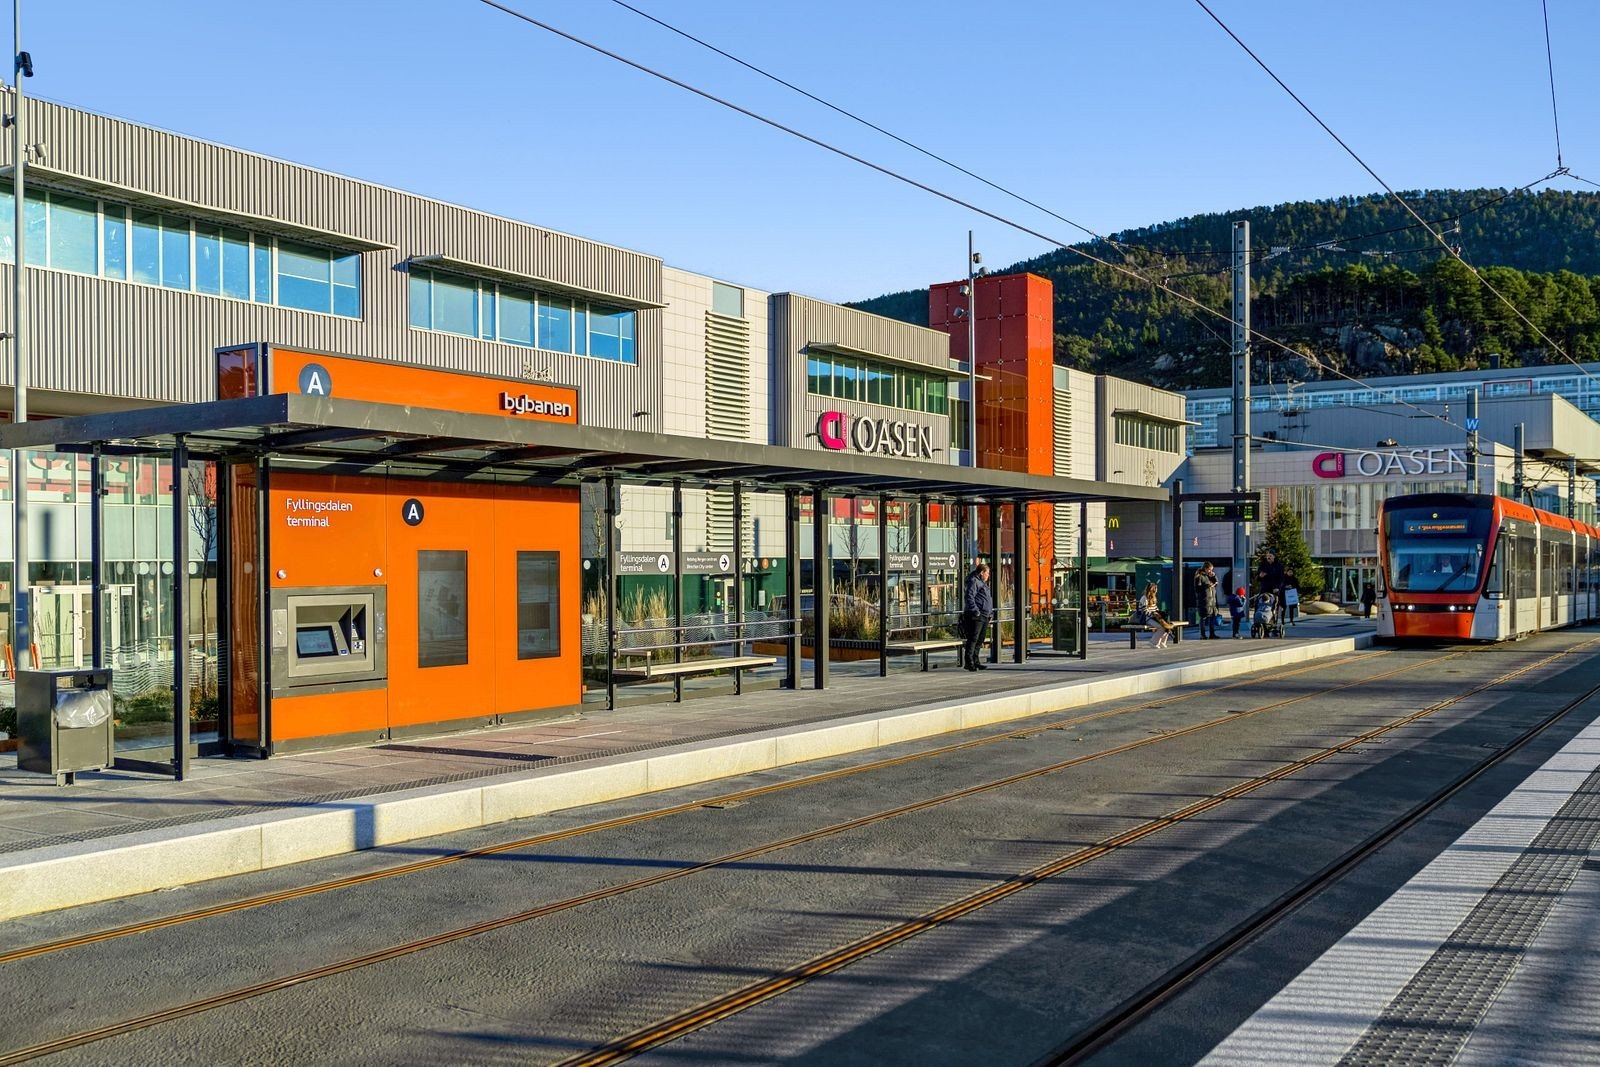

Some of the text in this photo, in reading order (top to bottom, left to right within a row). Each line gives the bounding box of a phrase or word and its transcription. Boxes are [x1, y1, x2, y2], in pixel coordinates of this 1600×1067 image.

[307, 371, 325, 395] A
[504, 391, 572, 416] bybanen
[1467, 420, 1479, 431] W
[856, 416, 933, 459] OASEN
[1357, 448, 1468, 477] OASEN
[286, 498, 353, 512] Fyllingsdalen
[407, 503, 420, 520] A
[286, 515, 330, 527] terminal
[620, 554, 656, 565] Fyllingsdalen
[620, 564, 644, 572] terminal
